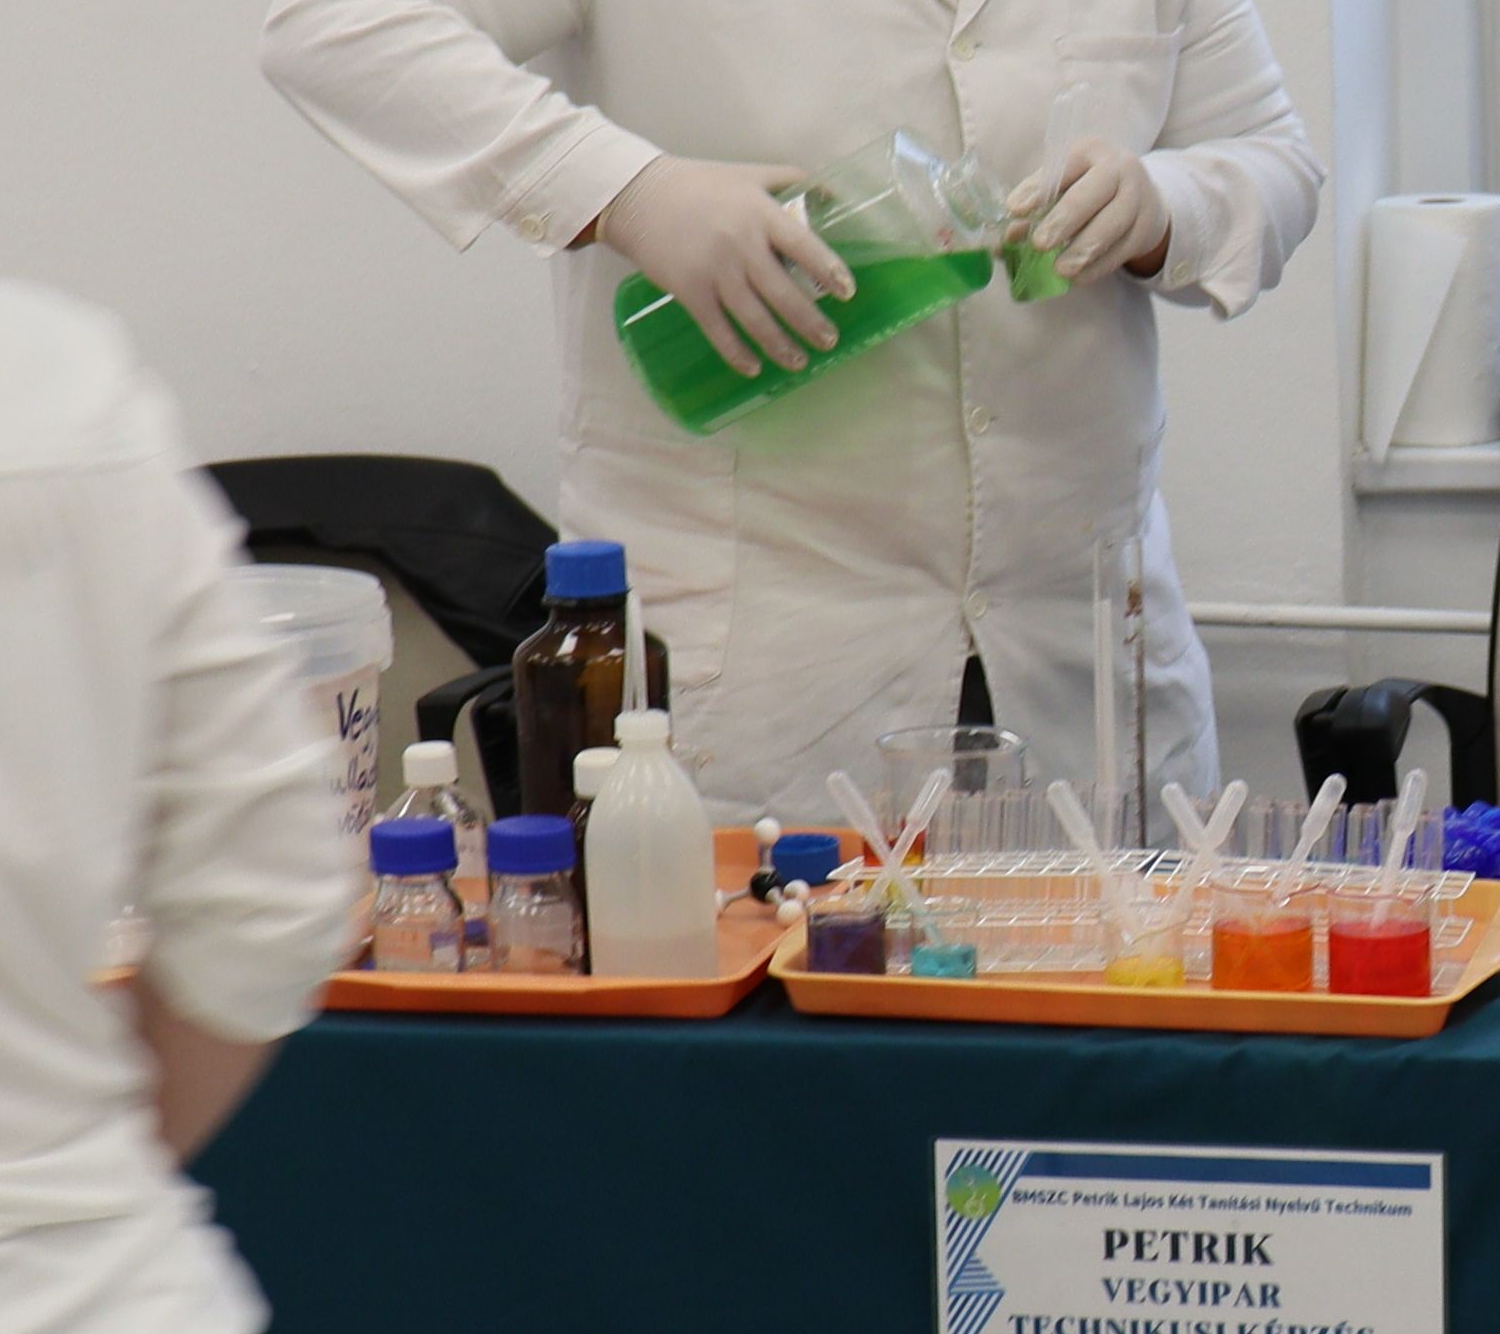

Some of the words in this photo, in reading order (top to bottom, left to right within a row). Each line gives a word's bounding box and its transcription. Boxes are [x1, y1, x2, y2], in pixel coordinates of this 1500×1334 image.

[1072, 1191, 1118, 1208] Petrik
[1123, 1193, 1164, 1211] Lajos
[1325, 1199, 1413, 1217] Technikum
[1102, 1228, 1274, 1266] PETRIK
[1102, 1277, 1282, 1309] VEGYIPAR
